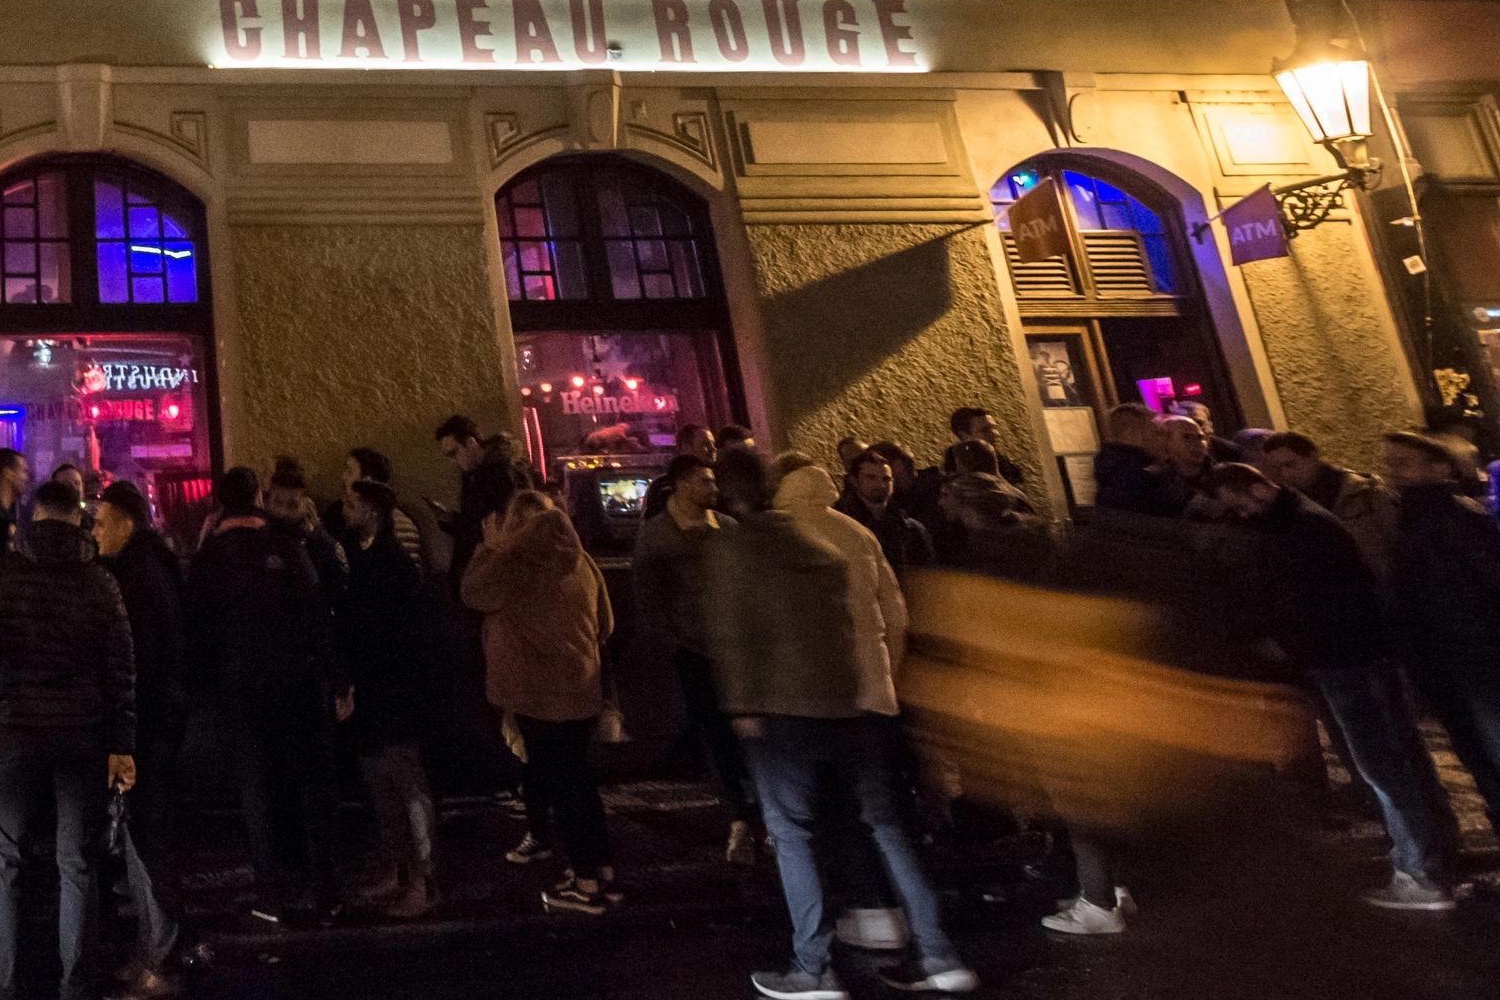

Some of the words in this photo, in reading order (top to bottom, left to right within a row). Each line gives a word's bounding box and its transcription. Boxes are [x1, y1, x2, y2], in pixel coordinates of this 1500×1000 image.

[1019, 214, 1058, 242] ATM
[1232, 219, 1278, 245] ATM
[560, 389, 679, 414] Heine
